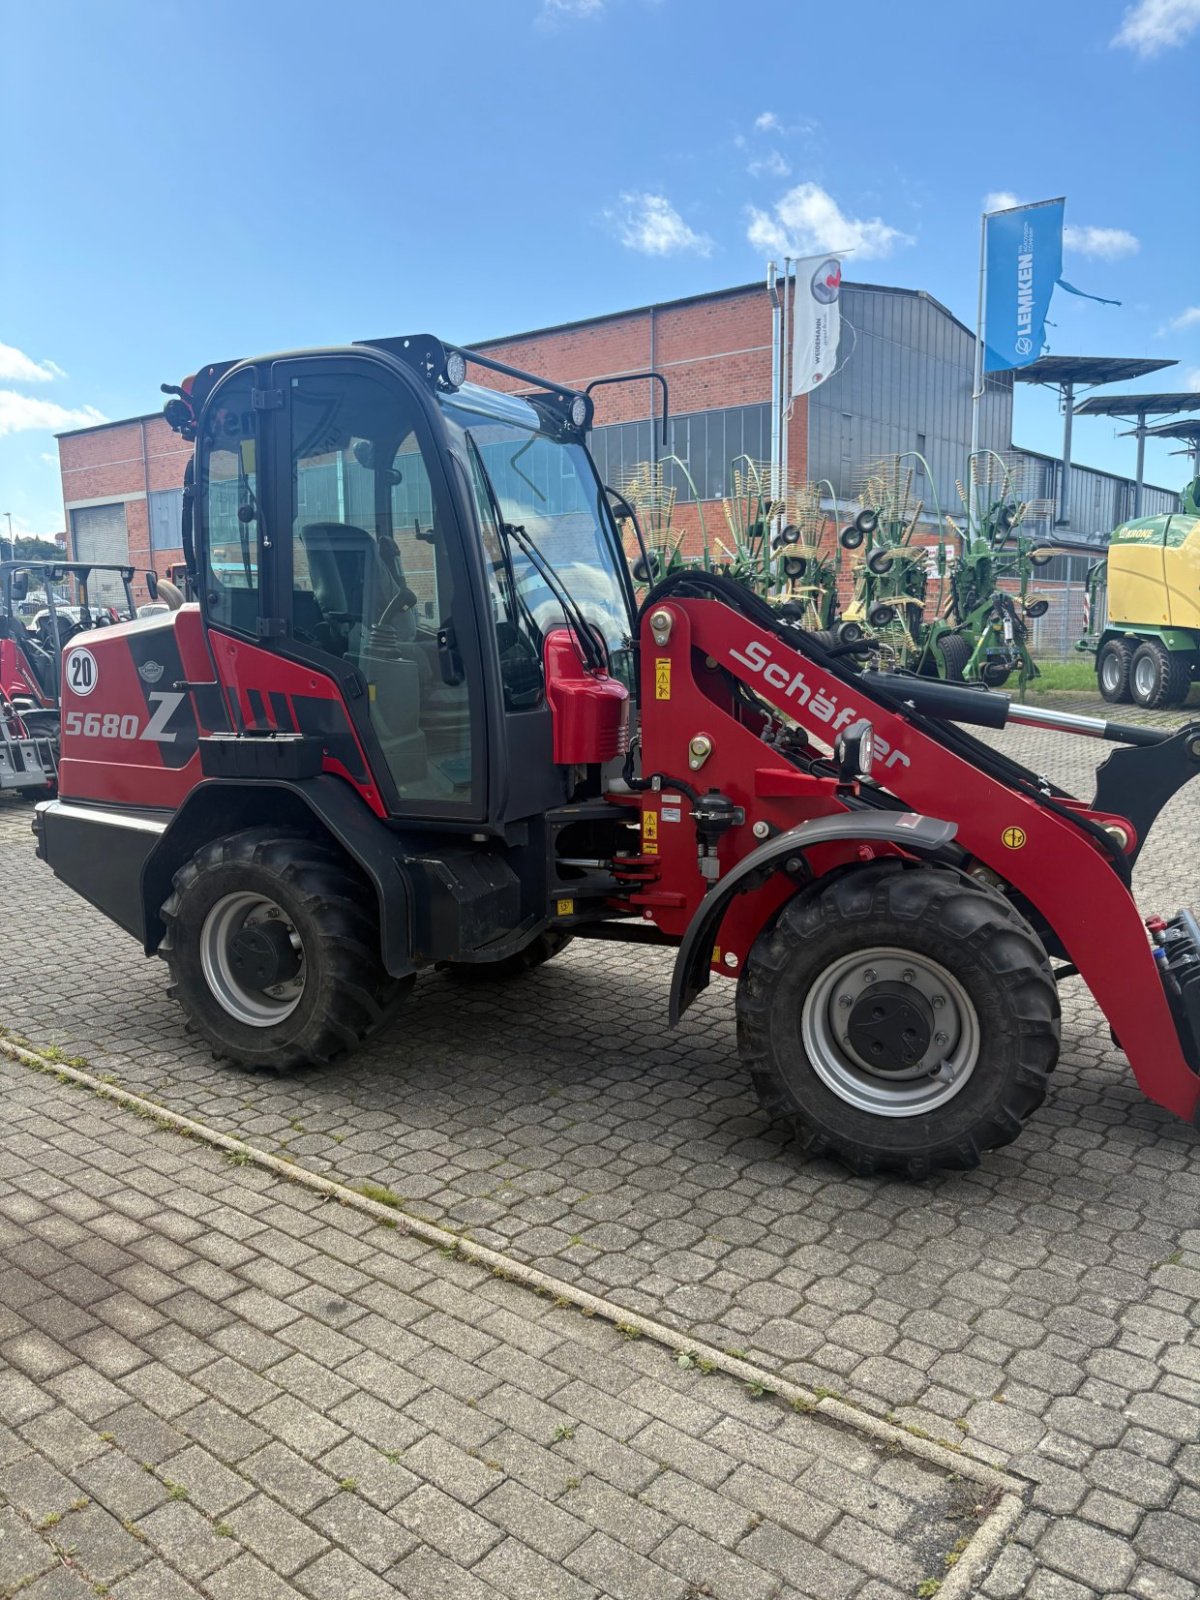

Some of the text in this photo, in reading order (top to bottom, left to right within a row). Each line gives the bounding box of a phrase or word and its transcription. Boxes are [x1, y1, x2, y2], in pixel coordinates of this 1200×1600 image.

[1017, 254, 1034, 336] LEMKEN
[1127, 528, 1153, 538] KRONE
[72, 657, 91, 686] 20
[66, 692, 186, 742] 5680 Z
[729, 641, 911, 768] Schäfer
